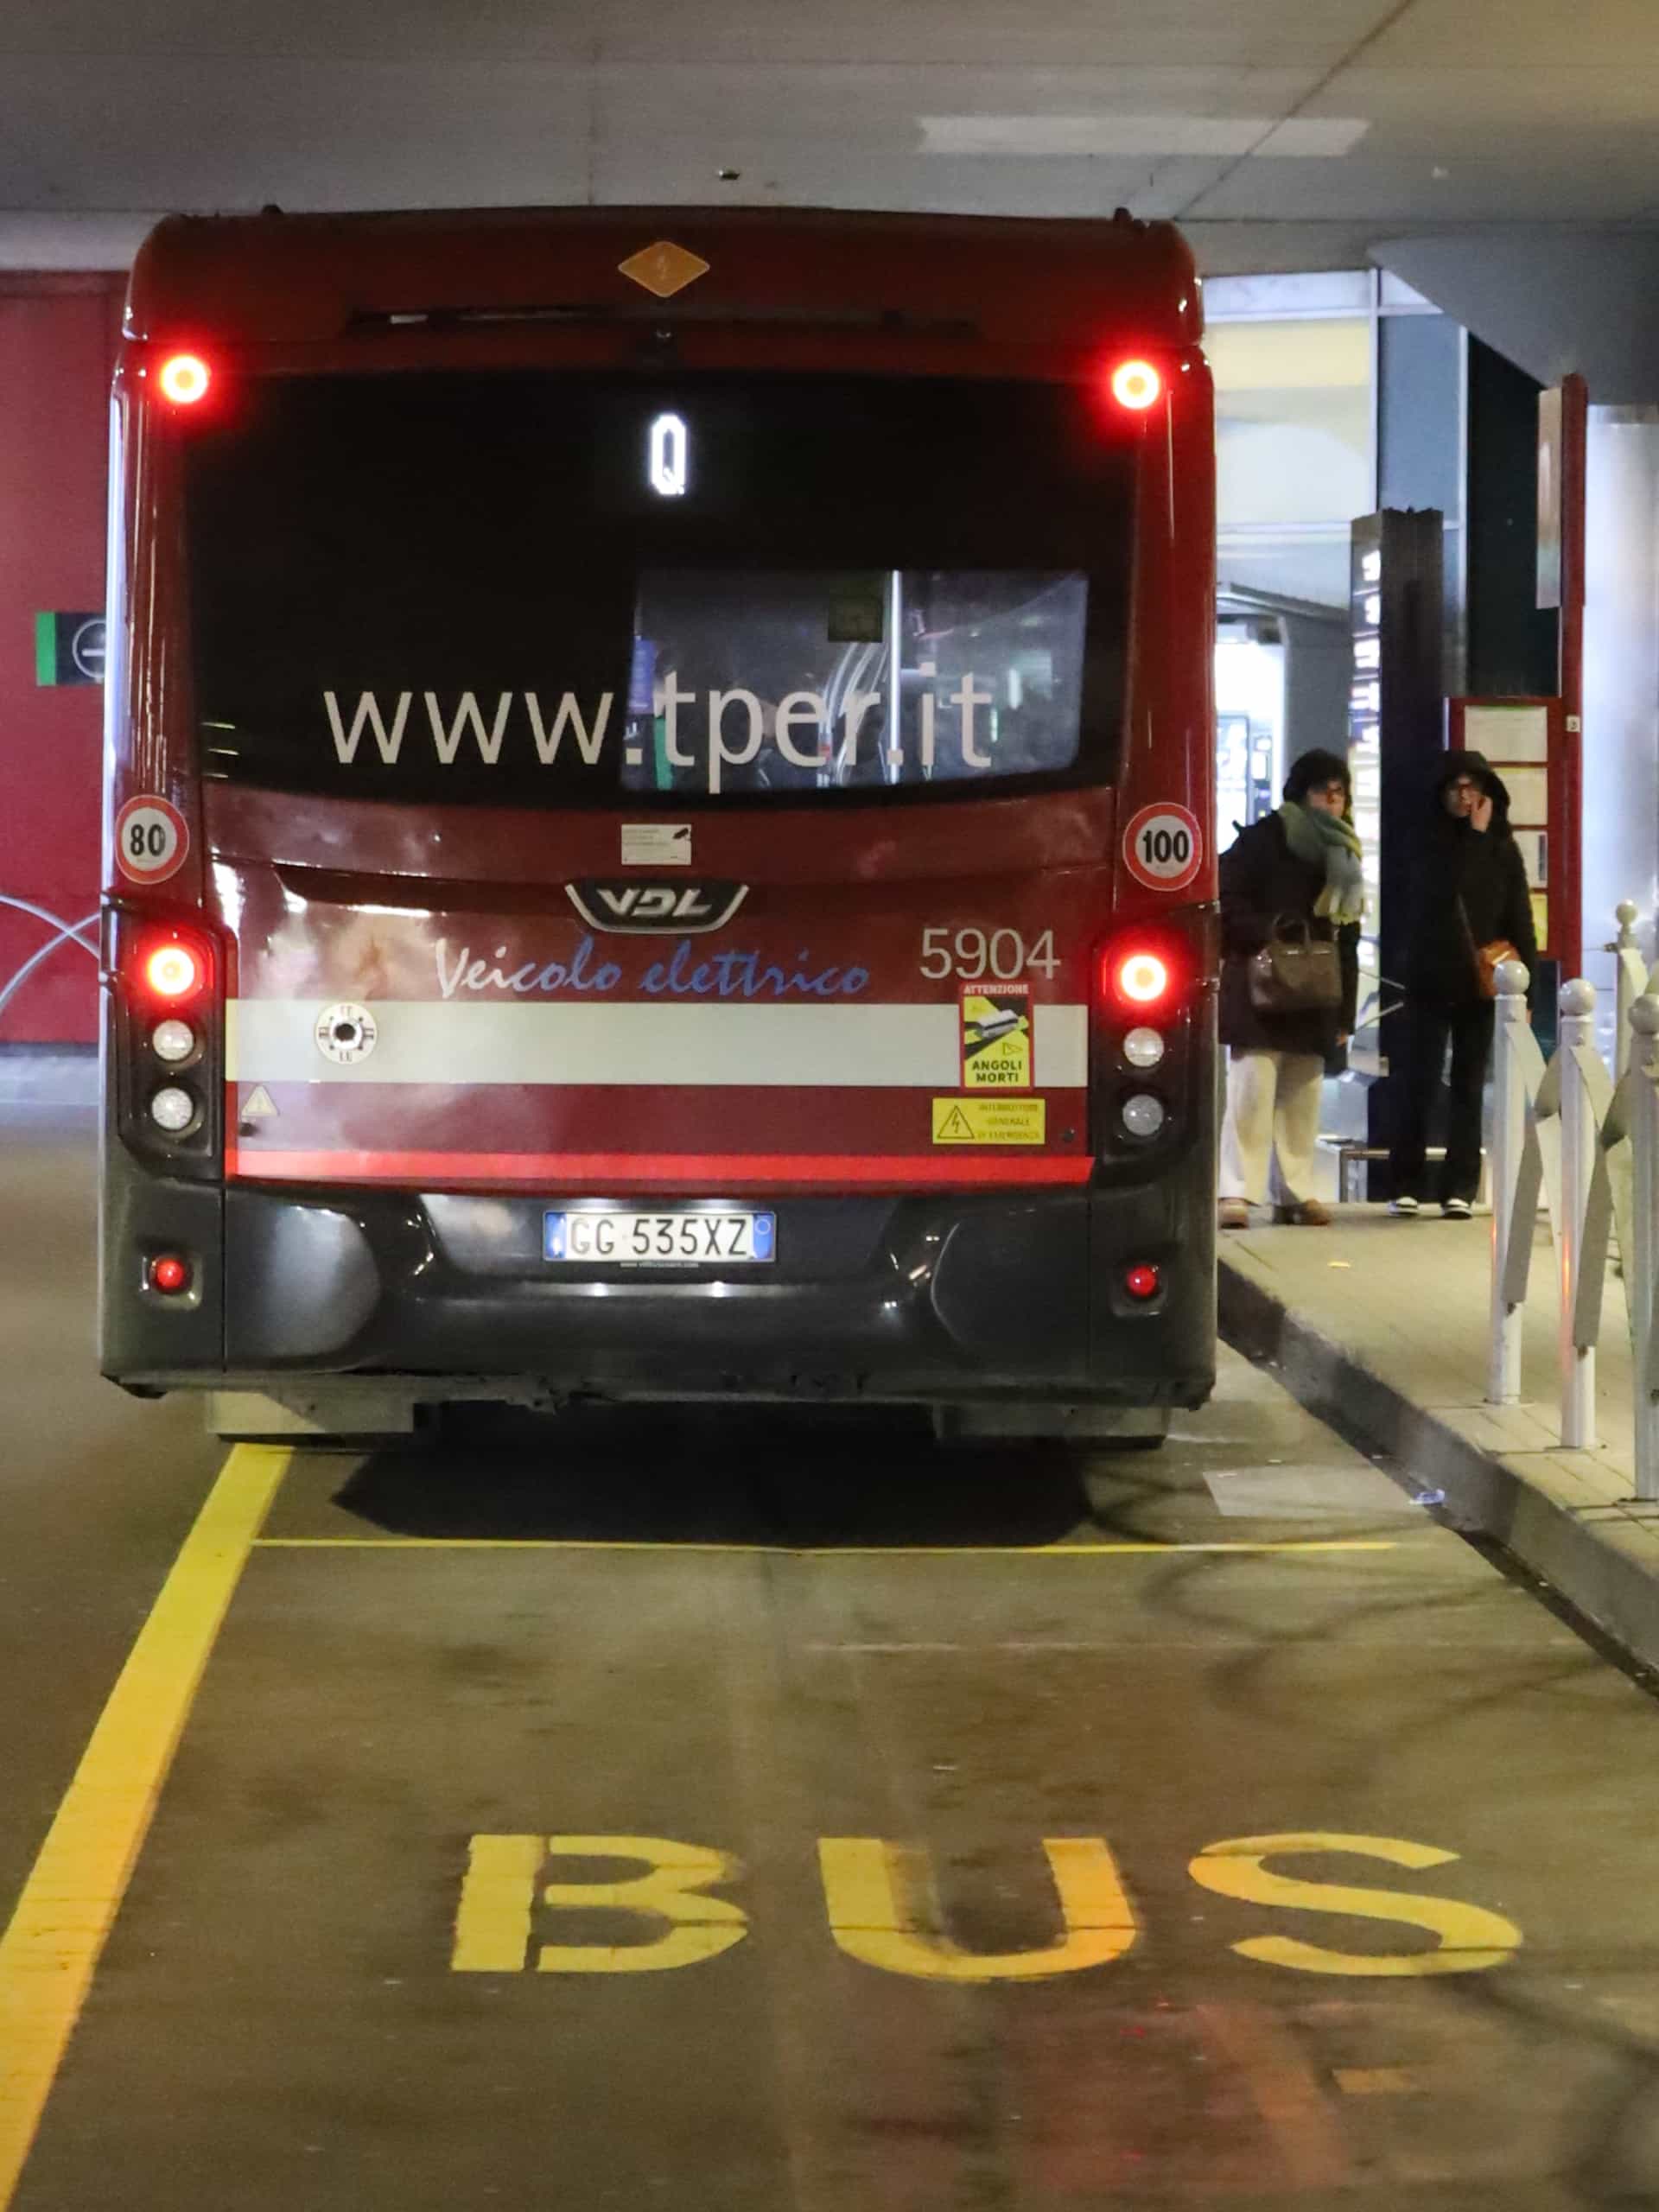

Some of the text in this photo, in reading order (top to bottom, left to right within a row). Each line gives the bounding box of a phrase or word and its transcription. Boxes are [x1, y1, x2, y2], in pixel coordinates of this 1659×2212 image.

[651, 413, 686, 495] Q
[323, 661, 993, 795] www.tper.it
[130, 823, 166, 856] 80
[1142, 830, 1190, 863] 100
[596, 887, 713, 917] VDL
[432, 936, 870, 1000] Veicolo elettrico
[919, 927, 1062, 980] 5904
[963, 983, 1029, 995] ATTENZIONE
[972, 1059, 1022, 1071] ANGOLI
[976, 1072, 1019, 1083] MORTI
[570, 1217, 747, 1255] GG 535XZ
[450, 1832, 1524, 1982] BUS
